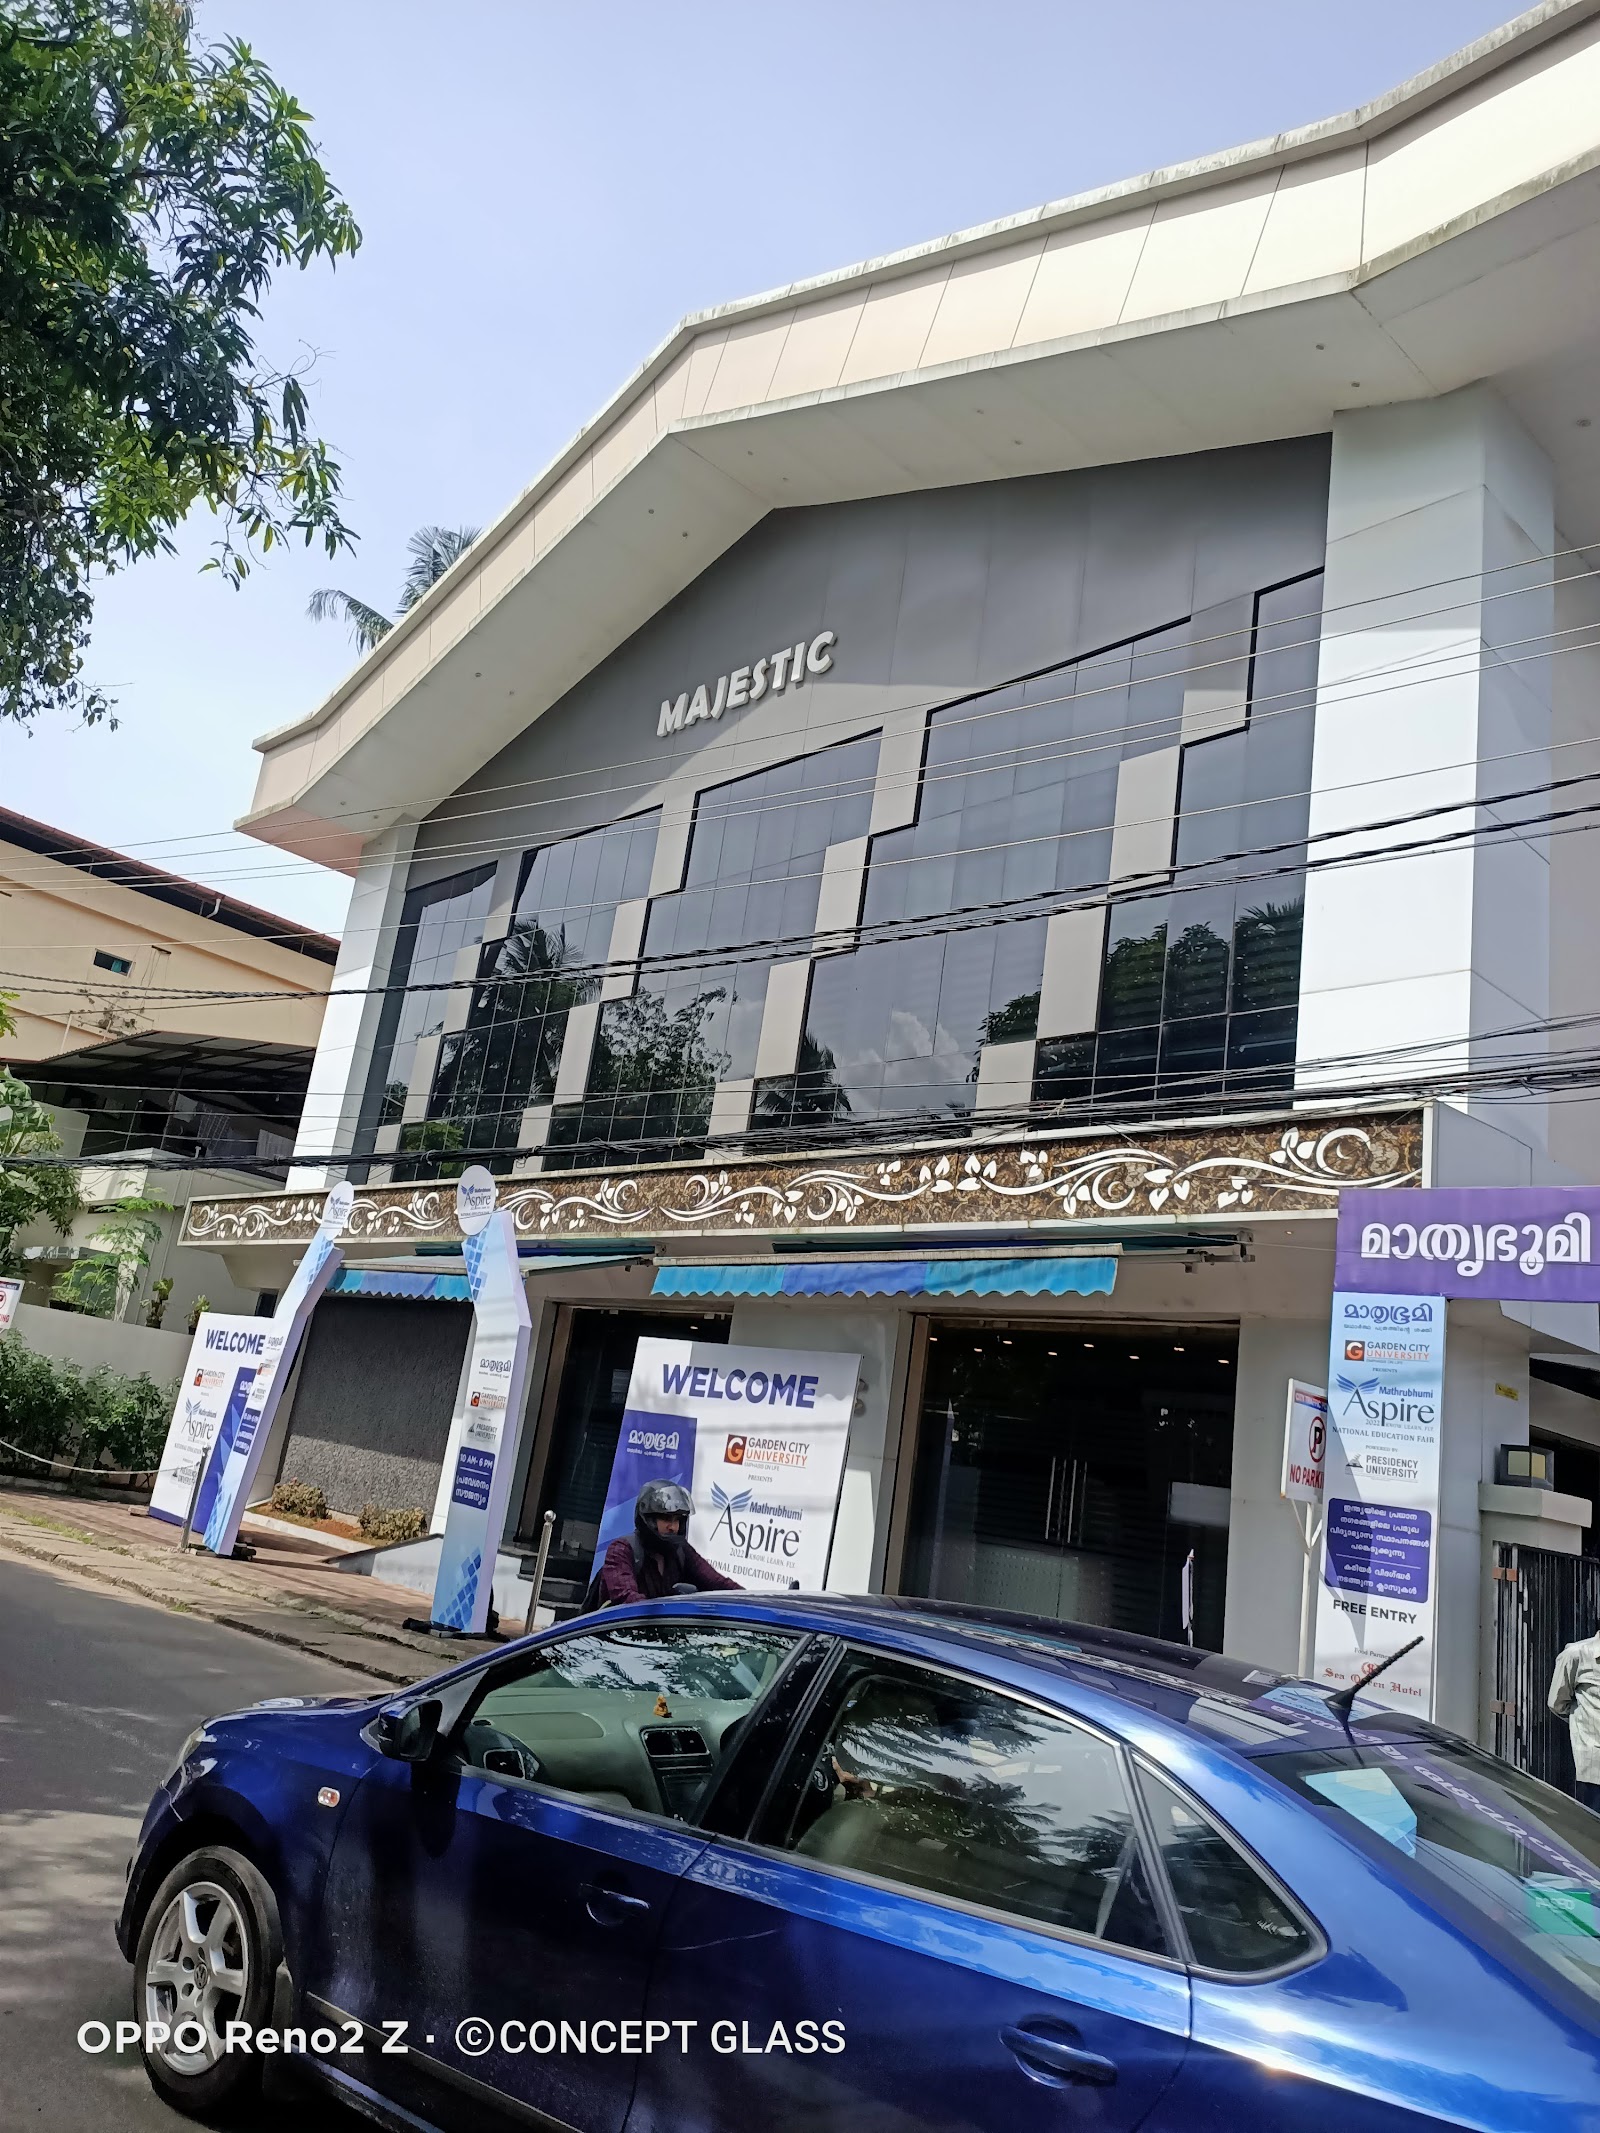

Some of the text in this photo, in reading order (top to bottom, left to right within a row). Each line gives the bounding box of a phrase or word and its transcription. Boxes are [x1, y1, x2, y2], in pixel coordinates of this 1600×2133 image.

[657, 630, 836, 738] MAJESTIC
[1361, 1212, 1590, 1277] മാതൃഭൂമി
[206, 1329, 266, 1355] WELCOME
[1367, 1341, 1430, 1352] GARDEN CITY
[1366, 1350, 1430, 1360] UNIVERSITY
[663, 1363, 819, 1409] WELCOME
[1379, 1386, 1434, 1399] Mathrubhumi
[481, 1392, 498, 1400] GARDEN
[1343, 1388, 1435, 1426] Aspire
[181, 1412, 215, 1442] Aspire
[1332, 1427, 1435, 1444] NATIONAL EDUCATION FAIR
[748, 1437, 810, 1455] GARDEN CITY
[479, 1458, 484, 1467] 6
[484, 1459, 494, 1469] PM
[746, 1449, 808, 1467] UNIVERSITY
[1366, 1455, 1419, 1469] PRESIDENCY
[748, 1474, 773, 1483] PRESENTS
[1290, 1464, 1301, 1483] NO
[1366, 1465, 1418, 1479] UNIVERSITY
[749, 1501, 804, 1521] Mathrubhumi
[709, 1503, 800, 1559] Aspire
[730, 1548, 745, 1559] 2022
[733, 1565, 775, 1582] EDUCATION
[776, 1576, 794, 1586] FAIR
[1333, 1599, 1417, 1624] FREE ENTRY
[1354, 1647, 1368, 1656] Food
[1322, 1668, 1345, 1680] Sea
[1390, 1682, 1422, 1697] Hotel
